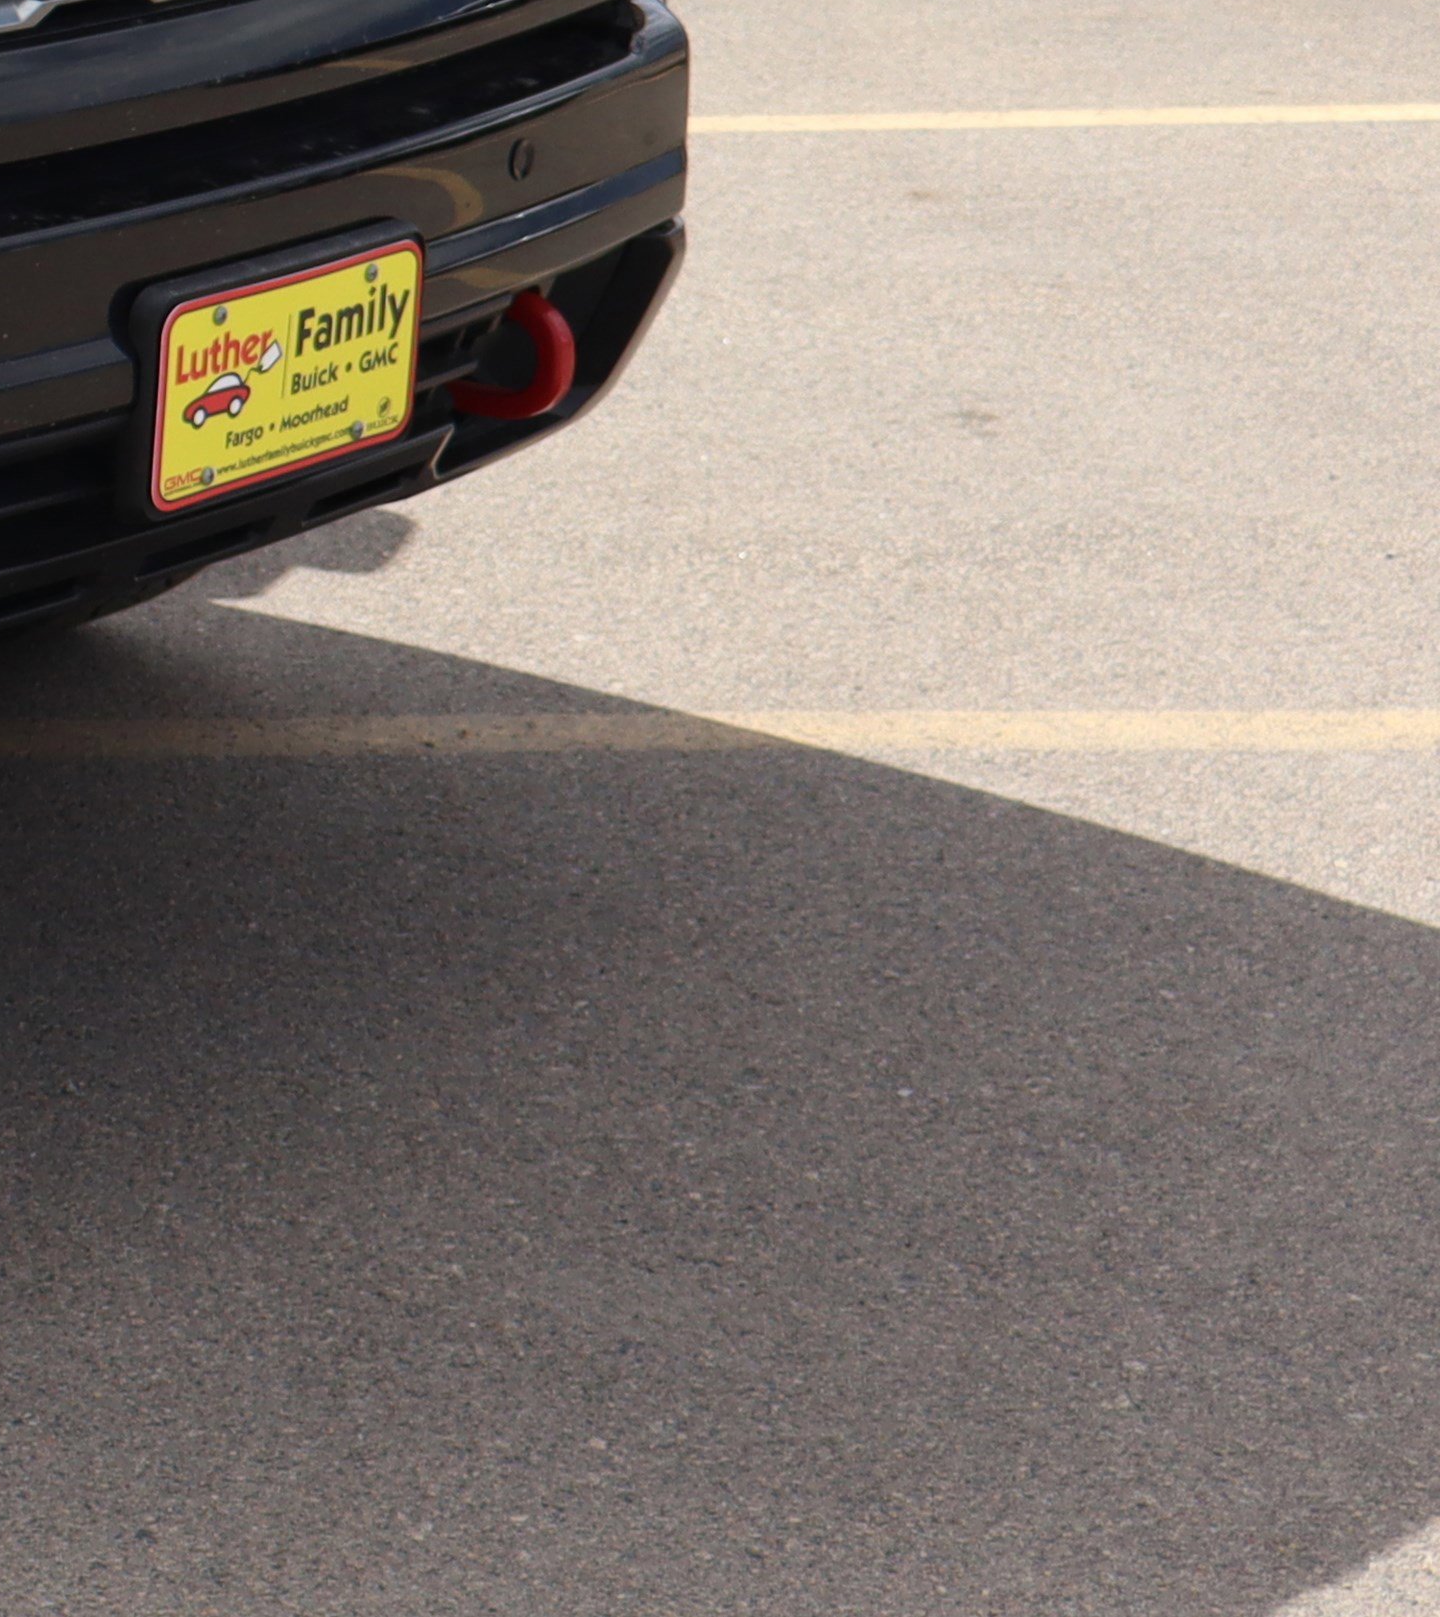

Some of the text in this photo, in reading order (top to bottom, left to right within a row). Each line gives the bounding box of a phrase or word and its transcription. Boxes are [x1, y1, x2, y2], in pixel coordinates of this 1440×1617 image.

[295, 283, 409, 357] Family
[175, 330, 273, 385] Luther
[291, 342, 398, 395] Buick GMC
[225, 396, 349, 449] Fargo Moorhead
[165, 467, 204, 491] GMC
